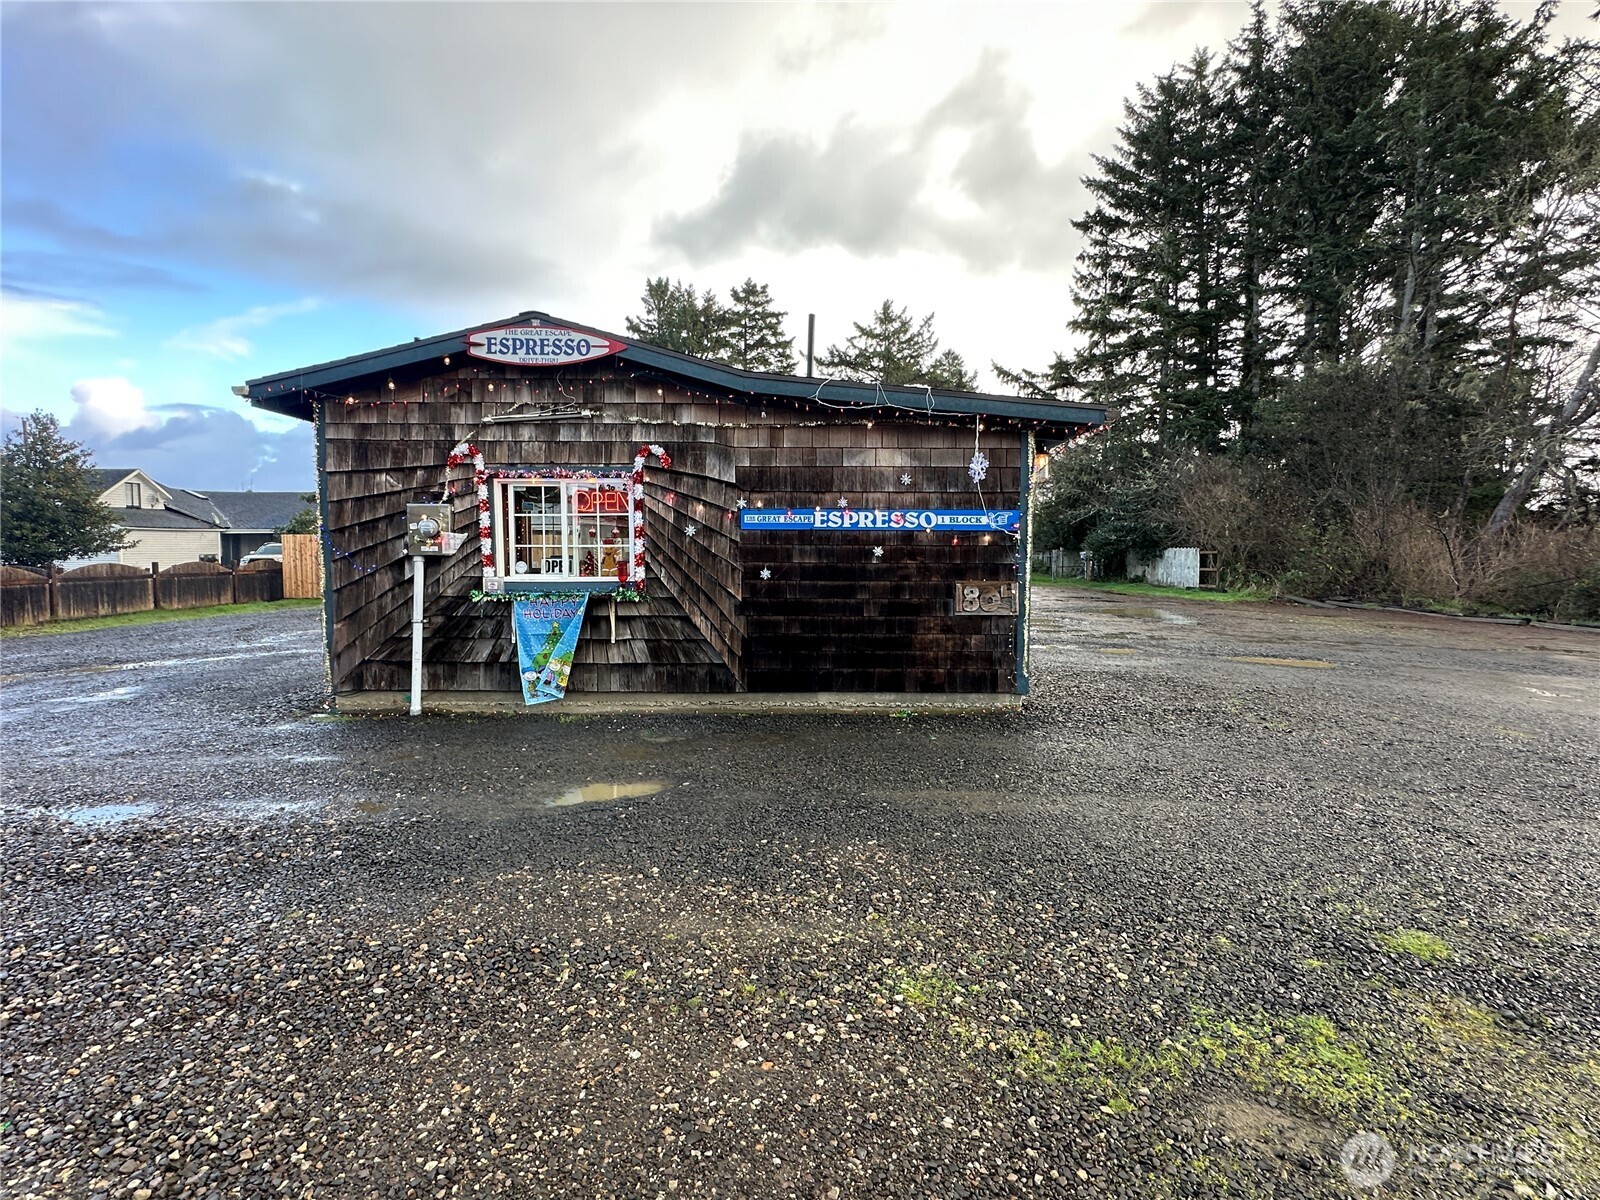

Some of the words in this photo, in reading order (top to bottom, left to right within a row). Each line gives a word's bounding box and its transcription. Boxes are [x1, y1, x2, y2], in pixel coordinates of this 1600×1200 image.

[485, 336, 591, 356] ESPRESSO
[572, 491, 630, 512] OPEN
[756, 515, 782, 523] GREAT
[784, 515, 813, 523] ESCAPE
[813, 511, 938, 528] ESPRESSO
